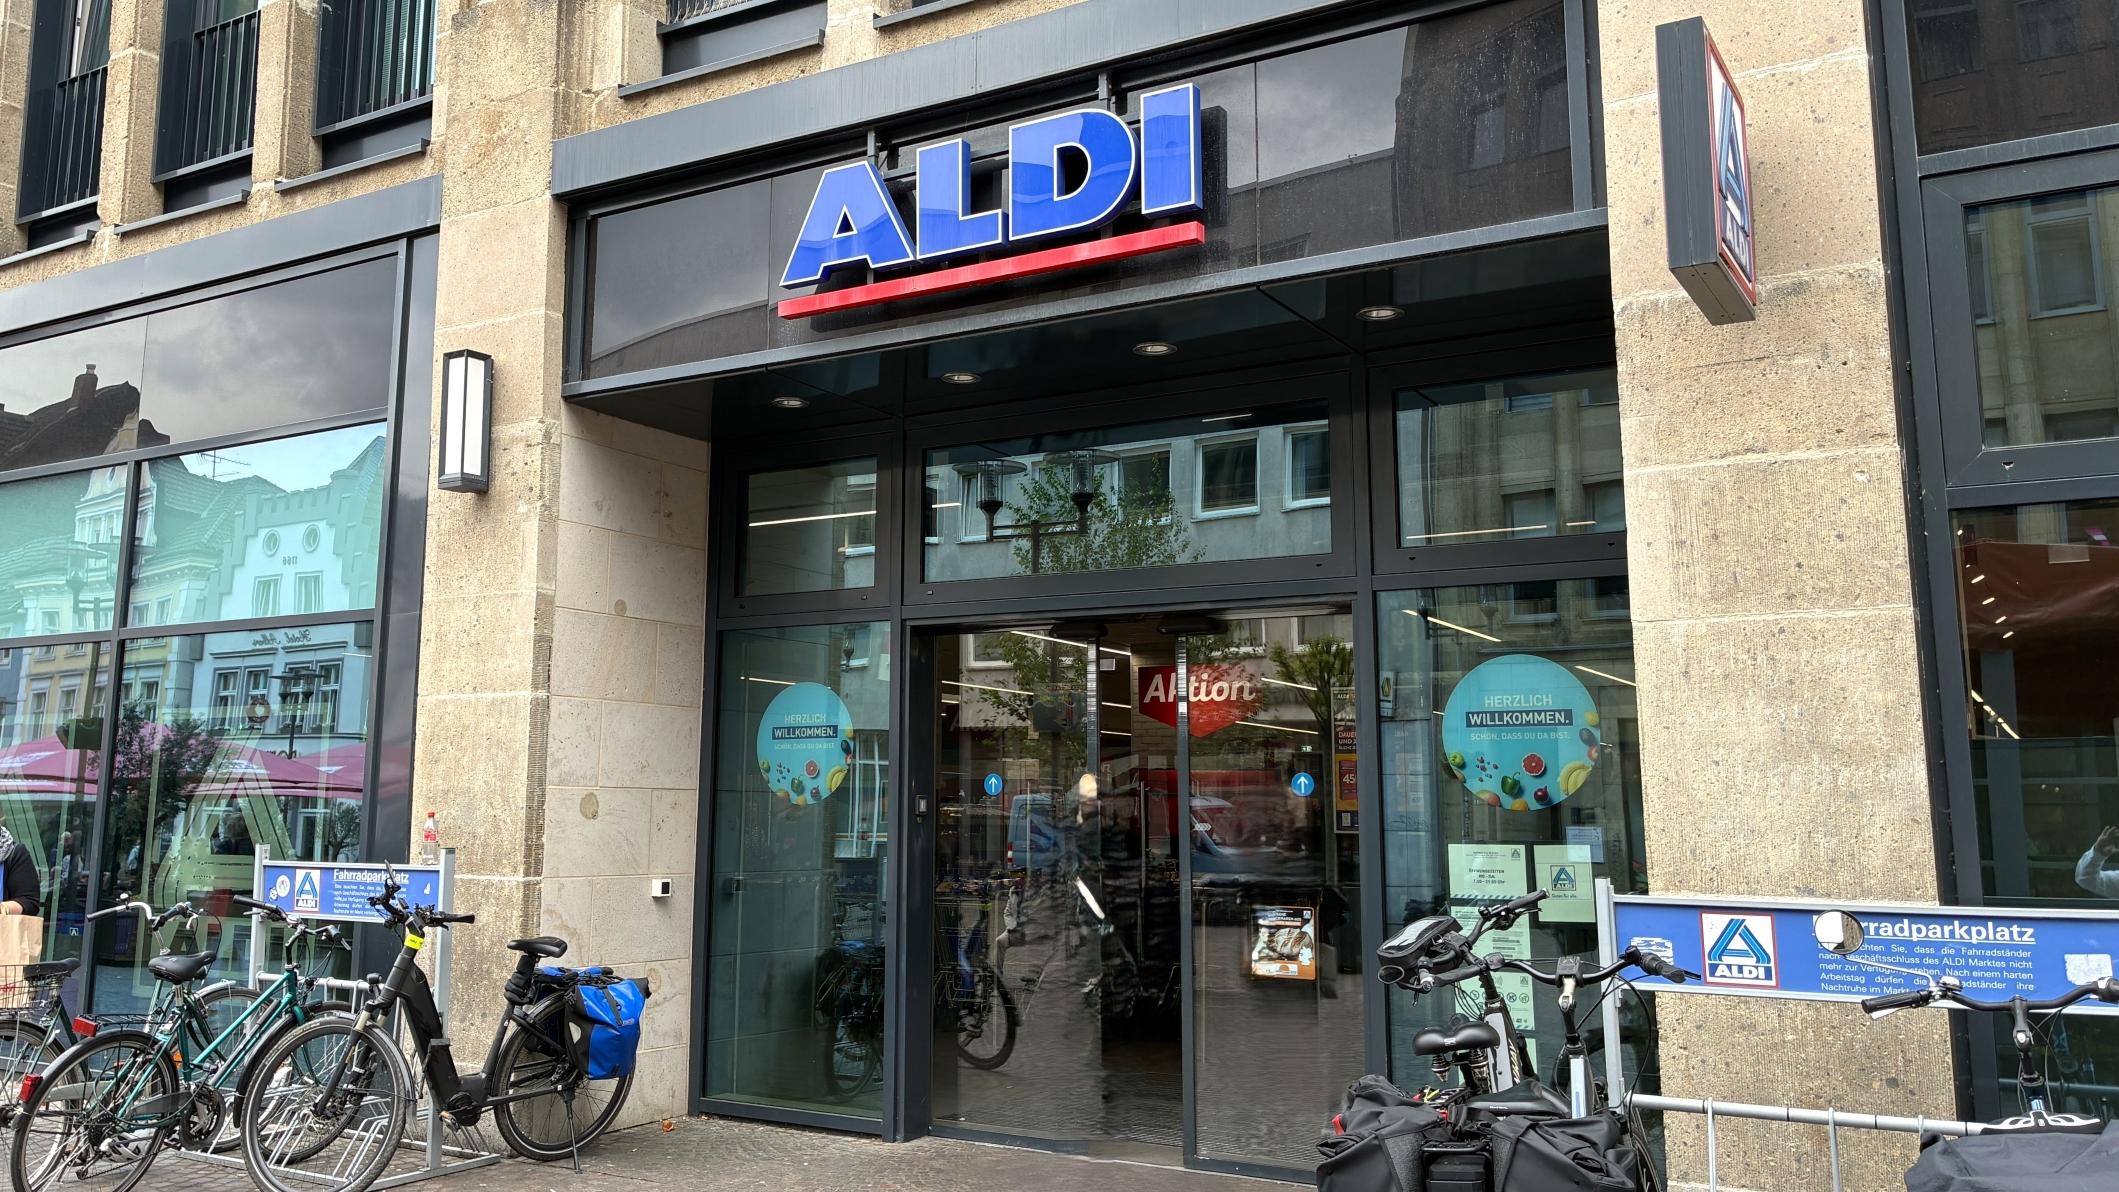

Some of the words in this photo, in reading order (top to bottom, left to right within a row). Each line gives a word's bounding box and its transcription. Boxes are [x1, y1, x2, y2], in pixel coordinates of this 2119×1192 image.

[780, 83, 1204, 288] ALDI
[1484, 694, 1553, 708] HERZLICH
[785, 713, 826, 724] HERZLICH
[1468, 711, 1570, 726] WILLKOMMEN.
[774, 726, 836, 739] WILLKOMMEN.
[1501, 732, 1522, 740] DASS
[1524, 732, 1536, 740] DU
[334, 868, 409, 884] Fahrradparklatz
[297, 899, 316, 908] ALDI
[1813, 916, 2036, 944] radparkplatz
[1891, 944, 1908, 954] Sie,
[1914, 945, 1936, 954] dass
[1941, 946, 1955, 955] die
[1961, 946, 2032, 958] Fahrradständer
[1922, 956, 1939, 965] des
[1942, 957, 1965, 966] ALDI
[1968, 958, 2006, 968] Marktes
[2009, 960, 2033, 969] nicht
[1714, 964, 1766, 980] ALDI
[1819, 962, 1842, 971] mehr
[1945, 967, 1970, 977] Nach
[1972, 969, 2001, 978] einem
[2003, 970, 2034, 980] harten
[1820, 972, 1866, 984] Arbeitstag
[1874, 974, 1904, 984] dürfen
[1913, 976, 1928, 986] die
[1962, 979, 2007, 989] adständer
[2016, 981, 2034, 991] ihre
[1821, 983, 1867, 993] Nachtruhe
[1869, 985, 1881, 994] im
